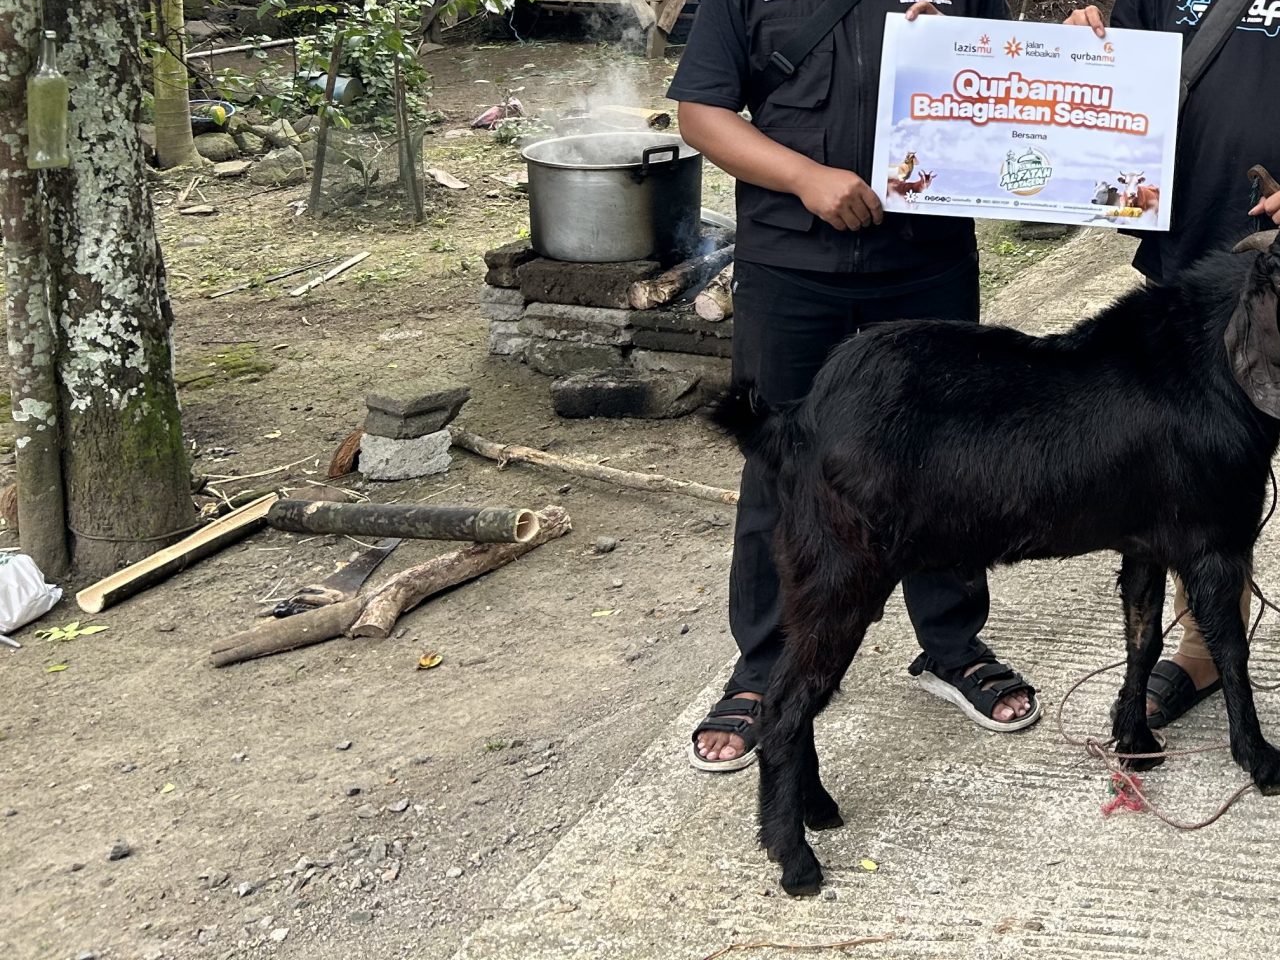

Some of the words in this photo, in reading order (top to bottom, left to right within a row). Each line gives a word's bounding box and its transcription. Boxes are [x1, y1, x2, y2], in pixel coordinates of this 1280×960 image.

[954, 41, 992, 54] lazismu
[1025, 41, 1044, 49] jalan
[1025, 48, 1060, 59] kebaikan
[1070, 51, 1116, 63] qurbanmu
[956, 71, 1111, 107] Qurbanmu
[913, 95, 1051, 123] Bahagiakan
[1054, 102, 1146, 132] Sesama
[1012, 130, 1048, 140] Bersama
